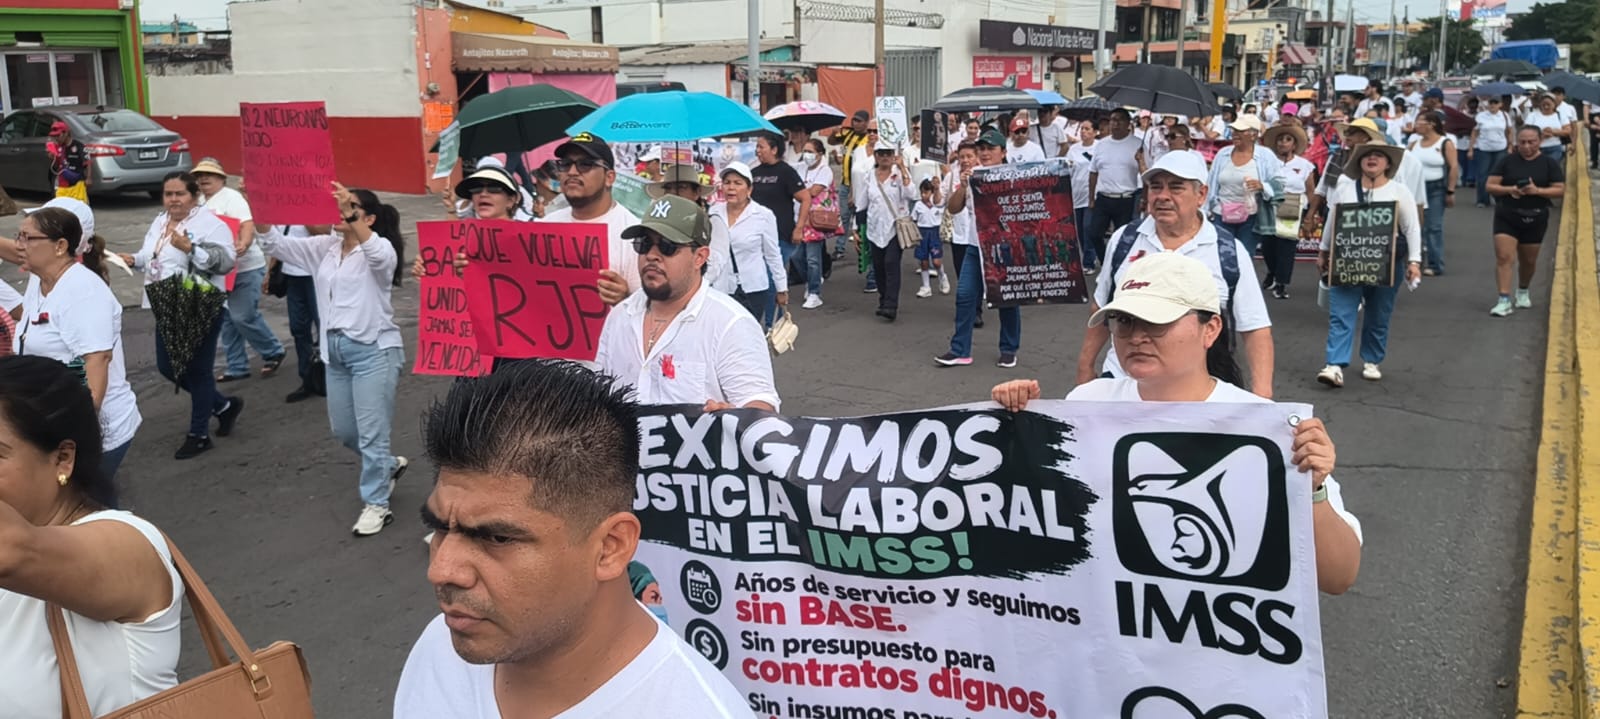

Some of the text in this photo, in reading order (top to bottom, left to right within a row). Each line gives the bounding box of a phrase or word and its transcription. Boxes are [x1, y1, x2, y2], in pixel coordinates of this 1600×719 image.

[1027, 27, 1053, 47] Nacional
[1053, 29, 1071, 48] Monte
[1079, 31, 1095, 49] Piedad
[252, 107, 262, 128] 2
[264, 107, 328, 130] NEURONAS
[611, 121, 672, 129] Betterware
[450, 223, 466, 240] LA
[1342, 208, 1393, 228] IMSS
[466, 223, 603, 270] QUE VUELVA
[1335, 232, 1389, 246] Salarios
[1341, 246, 1383, 258] Justos
[1336, 258, 1380, 272] Retiro
[1340, 272, 1377, 285] Digno
[427, 287, 469, 314] UNID
[1000, 284, 1012, 293] POR
[488, 273, 607, 351] RJP
[637, 412, 1003, 483] EXIGIMOS
[633, 472, 1075, 542] USTICIA LABORAL
[688, 517, 974, 575] EN EL IMSS!
[734, 572, 1081, 625] Años de servicio y seguimos
[735, 593, 907, 632] sin BASE.
[1114, 580, 1303, 665] IMSS
[740, 630, 996, 673] Sin presupuesto para
[742, 657, 1057, 719] contratos dignos.
[748, 692, 896, 719] Sin insumos
